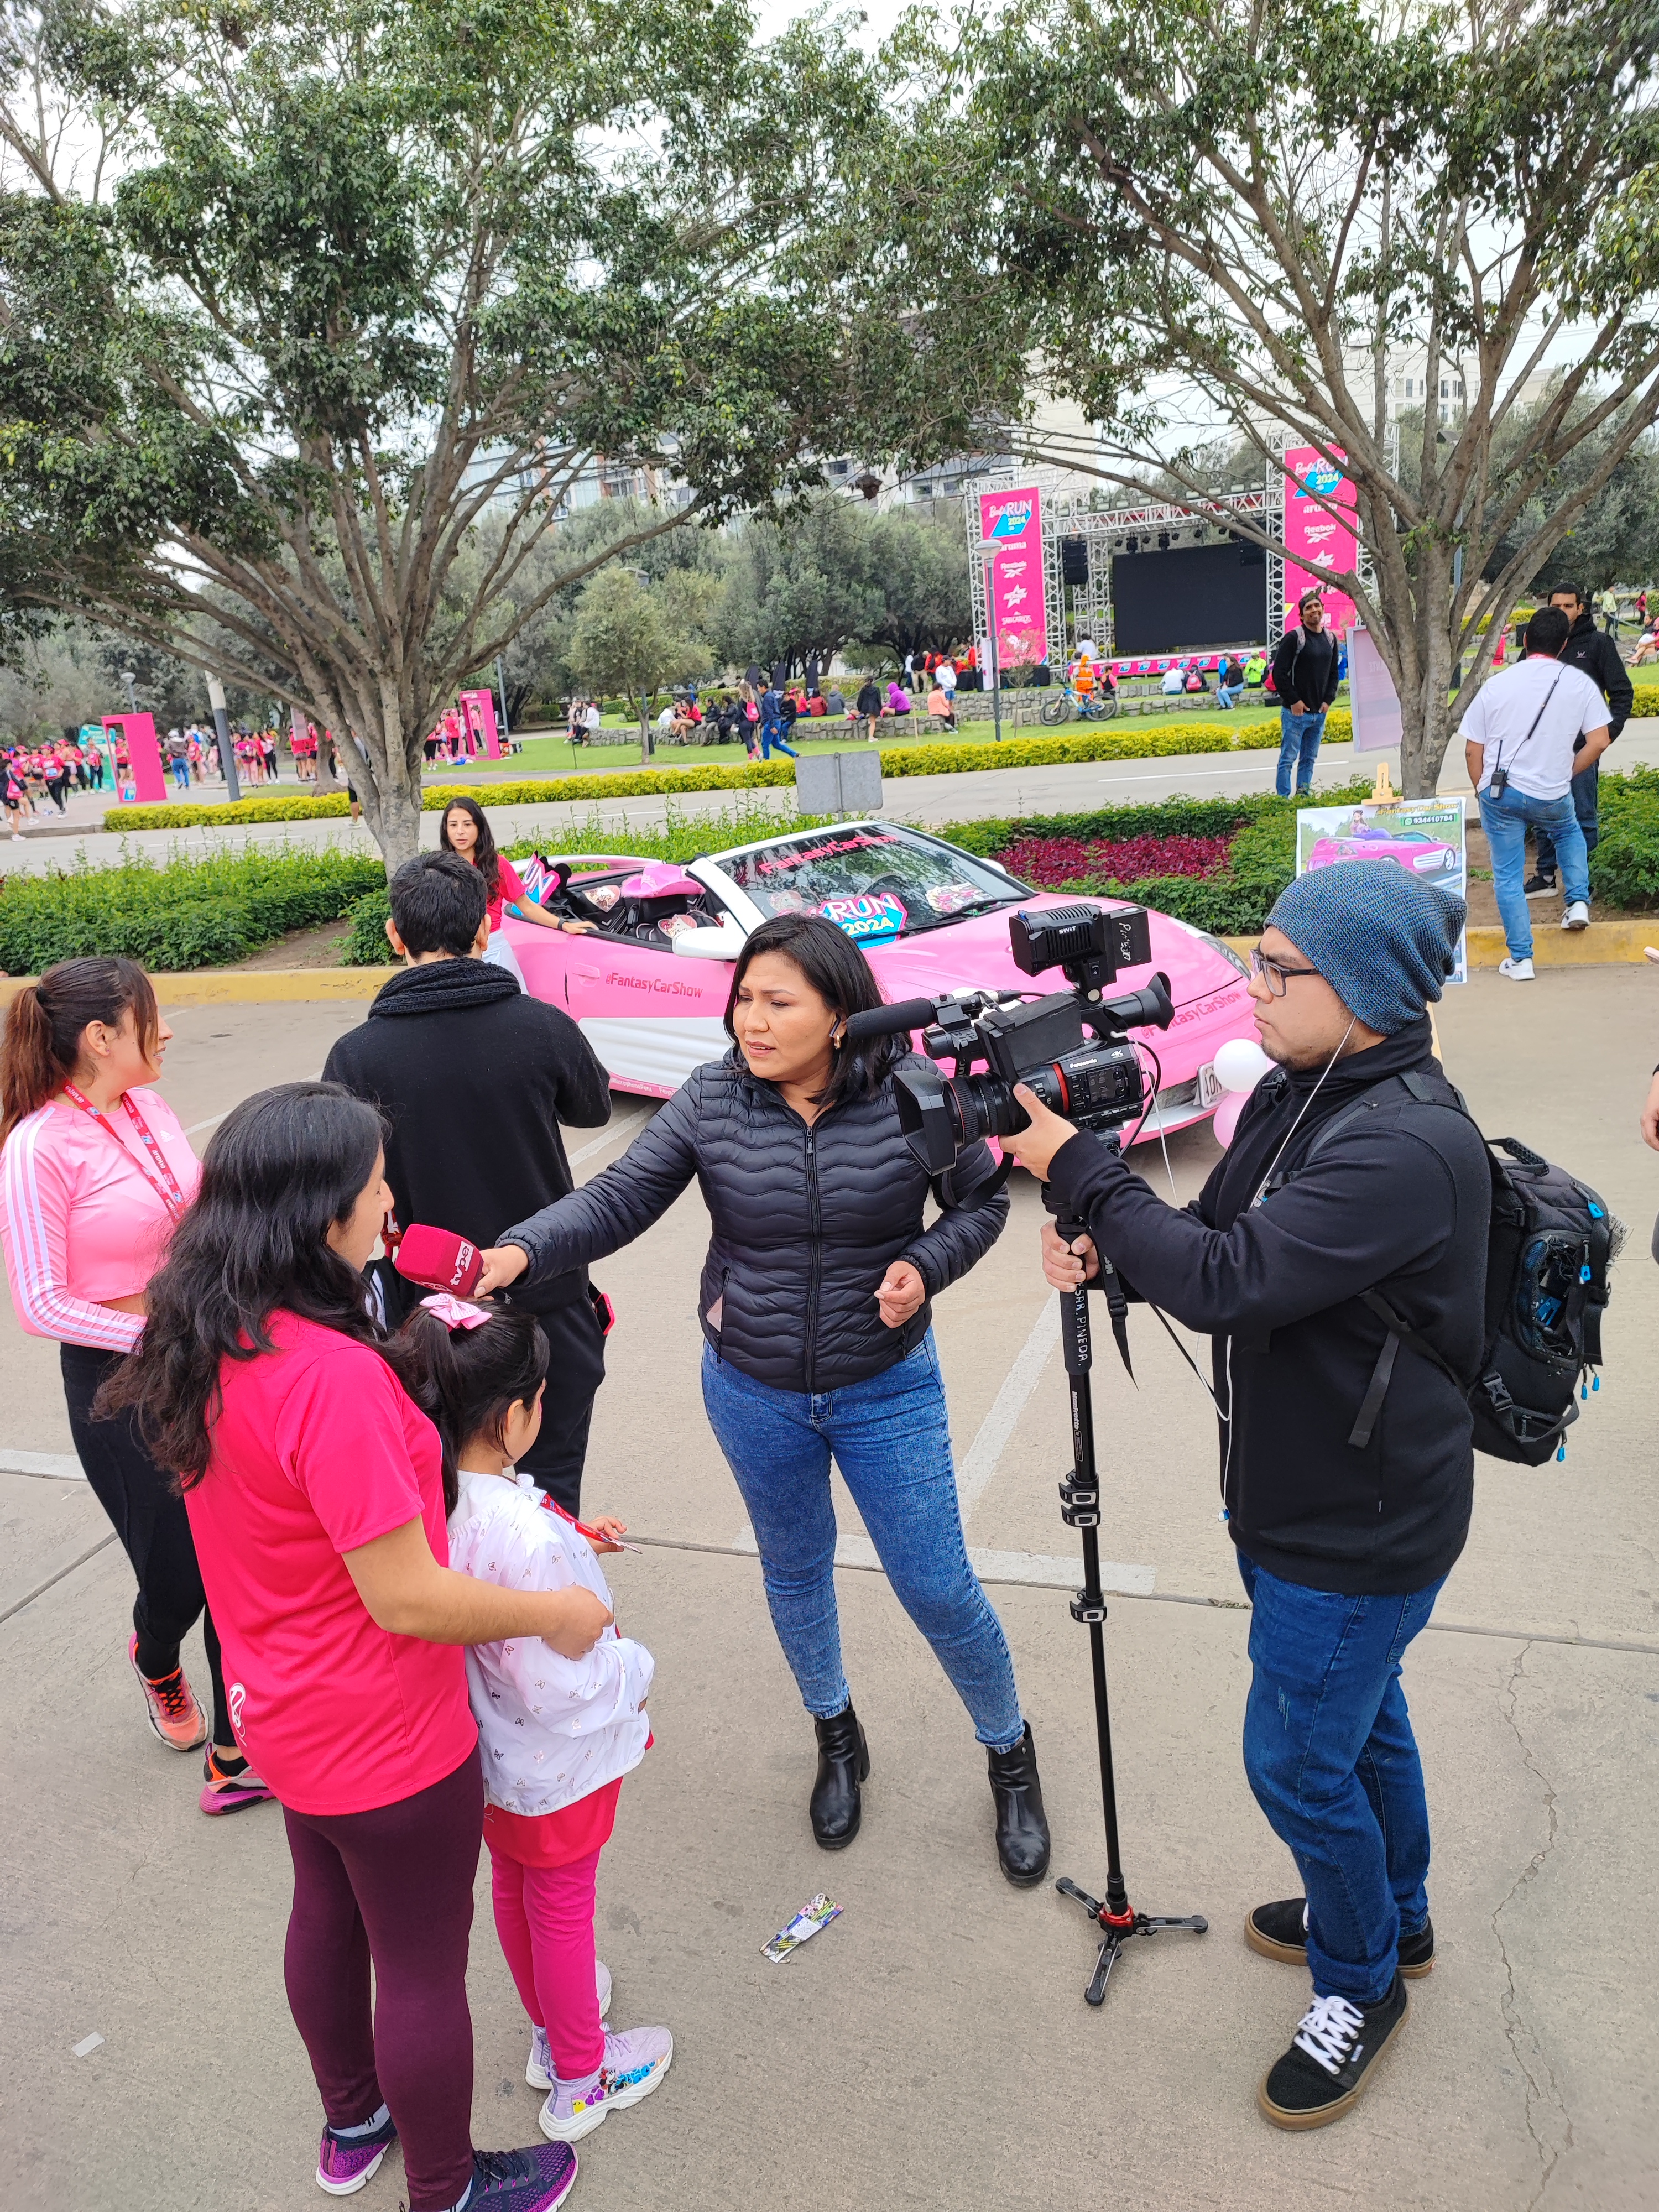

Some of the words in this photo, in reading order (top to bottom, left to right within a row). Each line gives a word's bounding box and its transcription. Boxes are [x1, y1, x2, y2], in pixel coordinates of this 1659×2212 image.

[1316, 472, 1339, 484] 2024
[1006, 499, 1032, 517] RUN
[1303, 502, 1338, 514] arua
[1304, 523, 1337, 534] Reebok
[827, 894, 899, 922] RUN
[842, 916, 895, 936] 2024
[606, 972, 703, 998] @FantasyCarShow
[1141, 990, 1243, 1039] @FtasyCarShow
[1069, 1057, 1098, 1069] Panasonic
